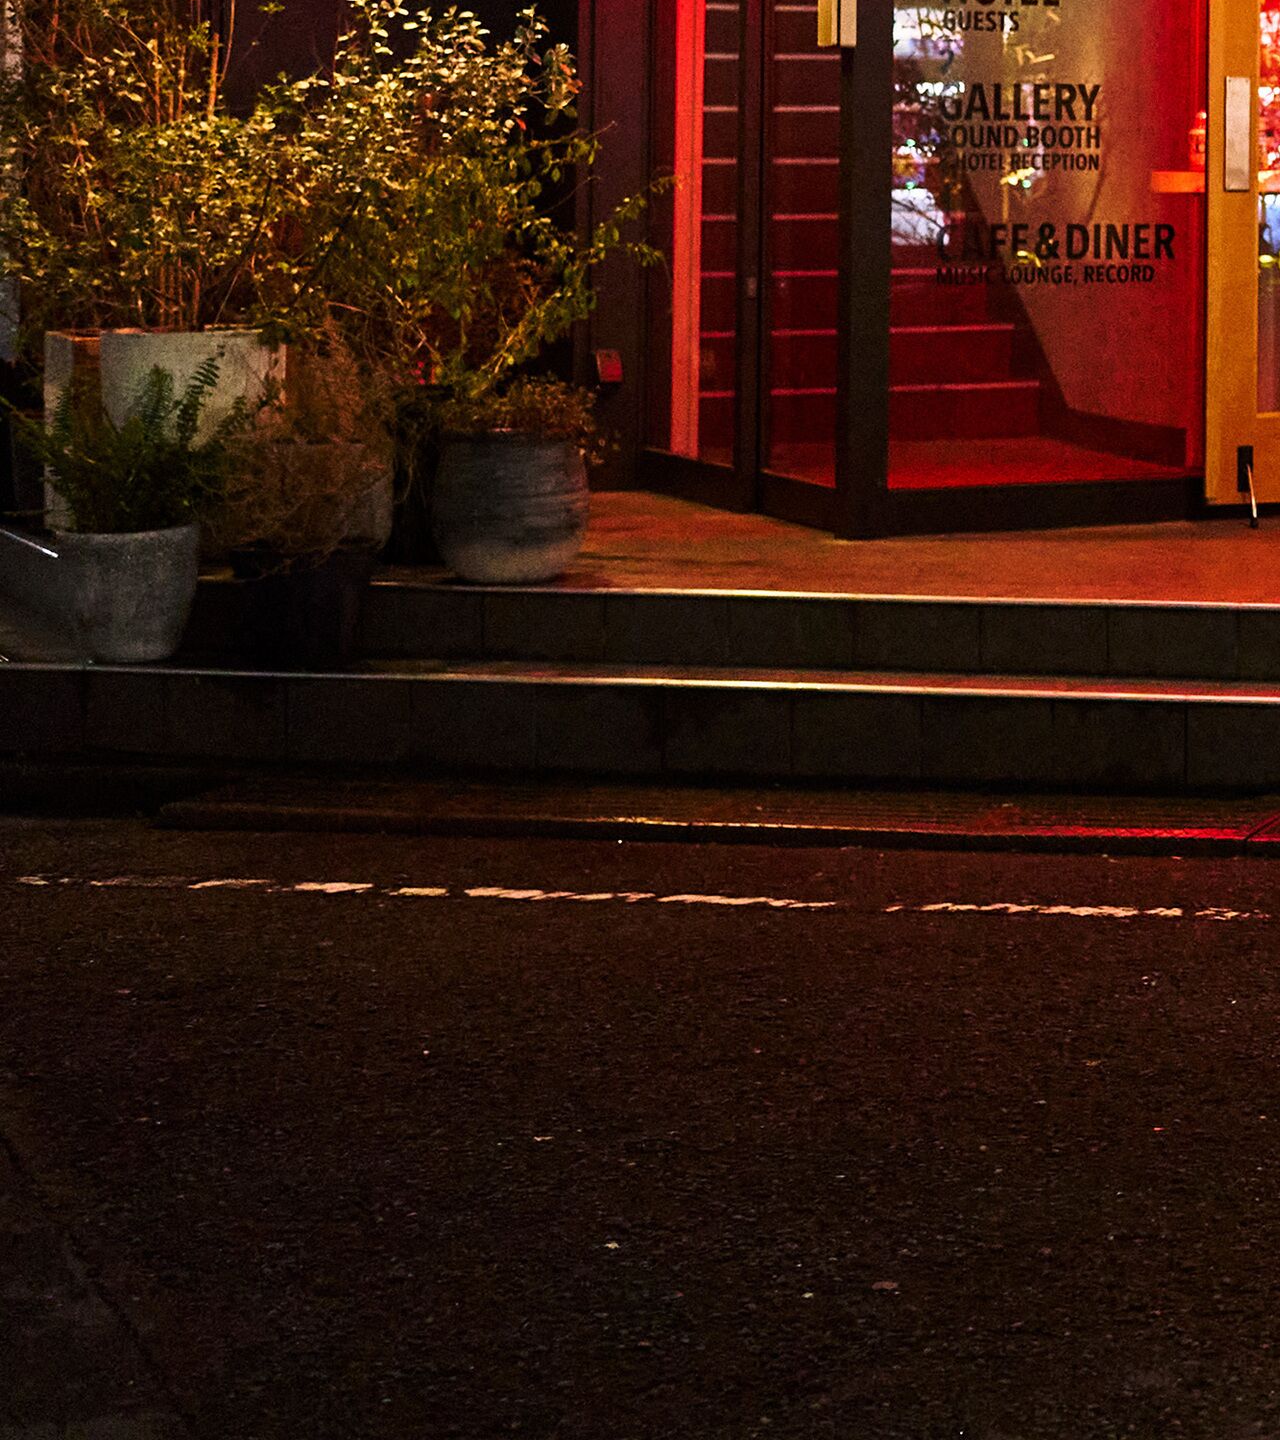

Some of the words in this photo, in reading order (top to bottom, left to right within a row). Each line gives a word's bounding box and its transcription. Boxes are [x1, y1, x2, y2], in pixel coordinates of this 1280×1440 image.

[943, 11, 1019, 32] GUESTS
[942, 82, 1101, 121] GALLERY
[1027, 126, 1101, 149] BOOTH
[1011, 152, 1099, 172] RECEPTION
[1083, 264, 1155, 284] RECORD
